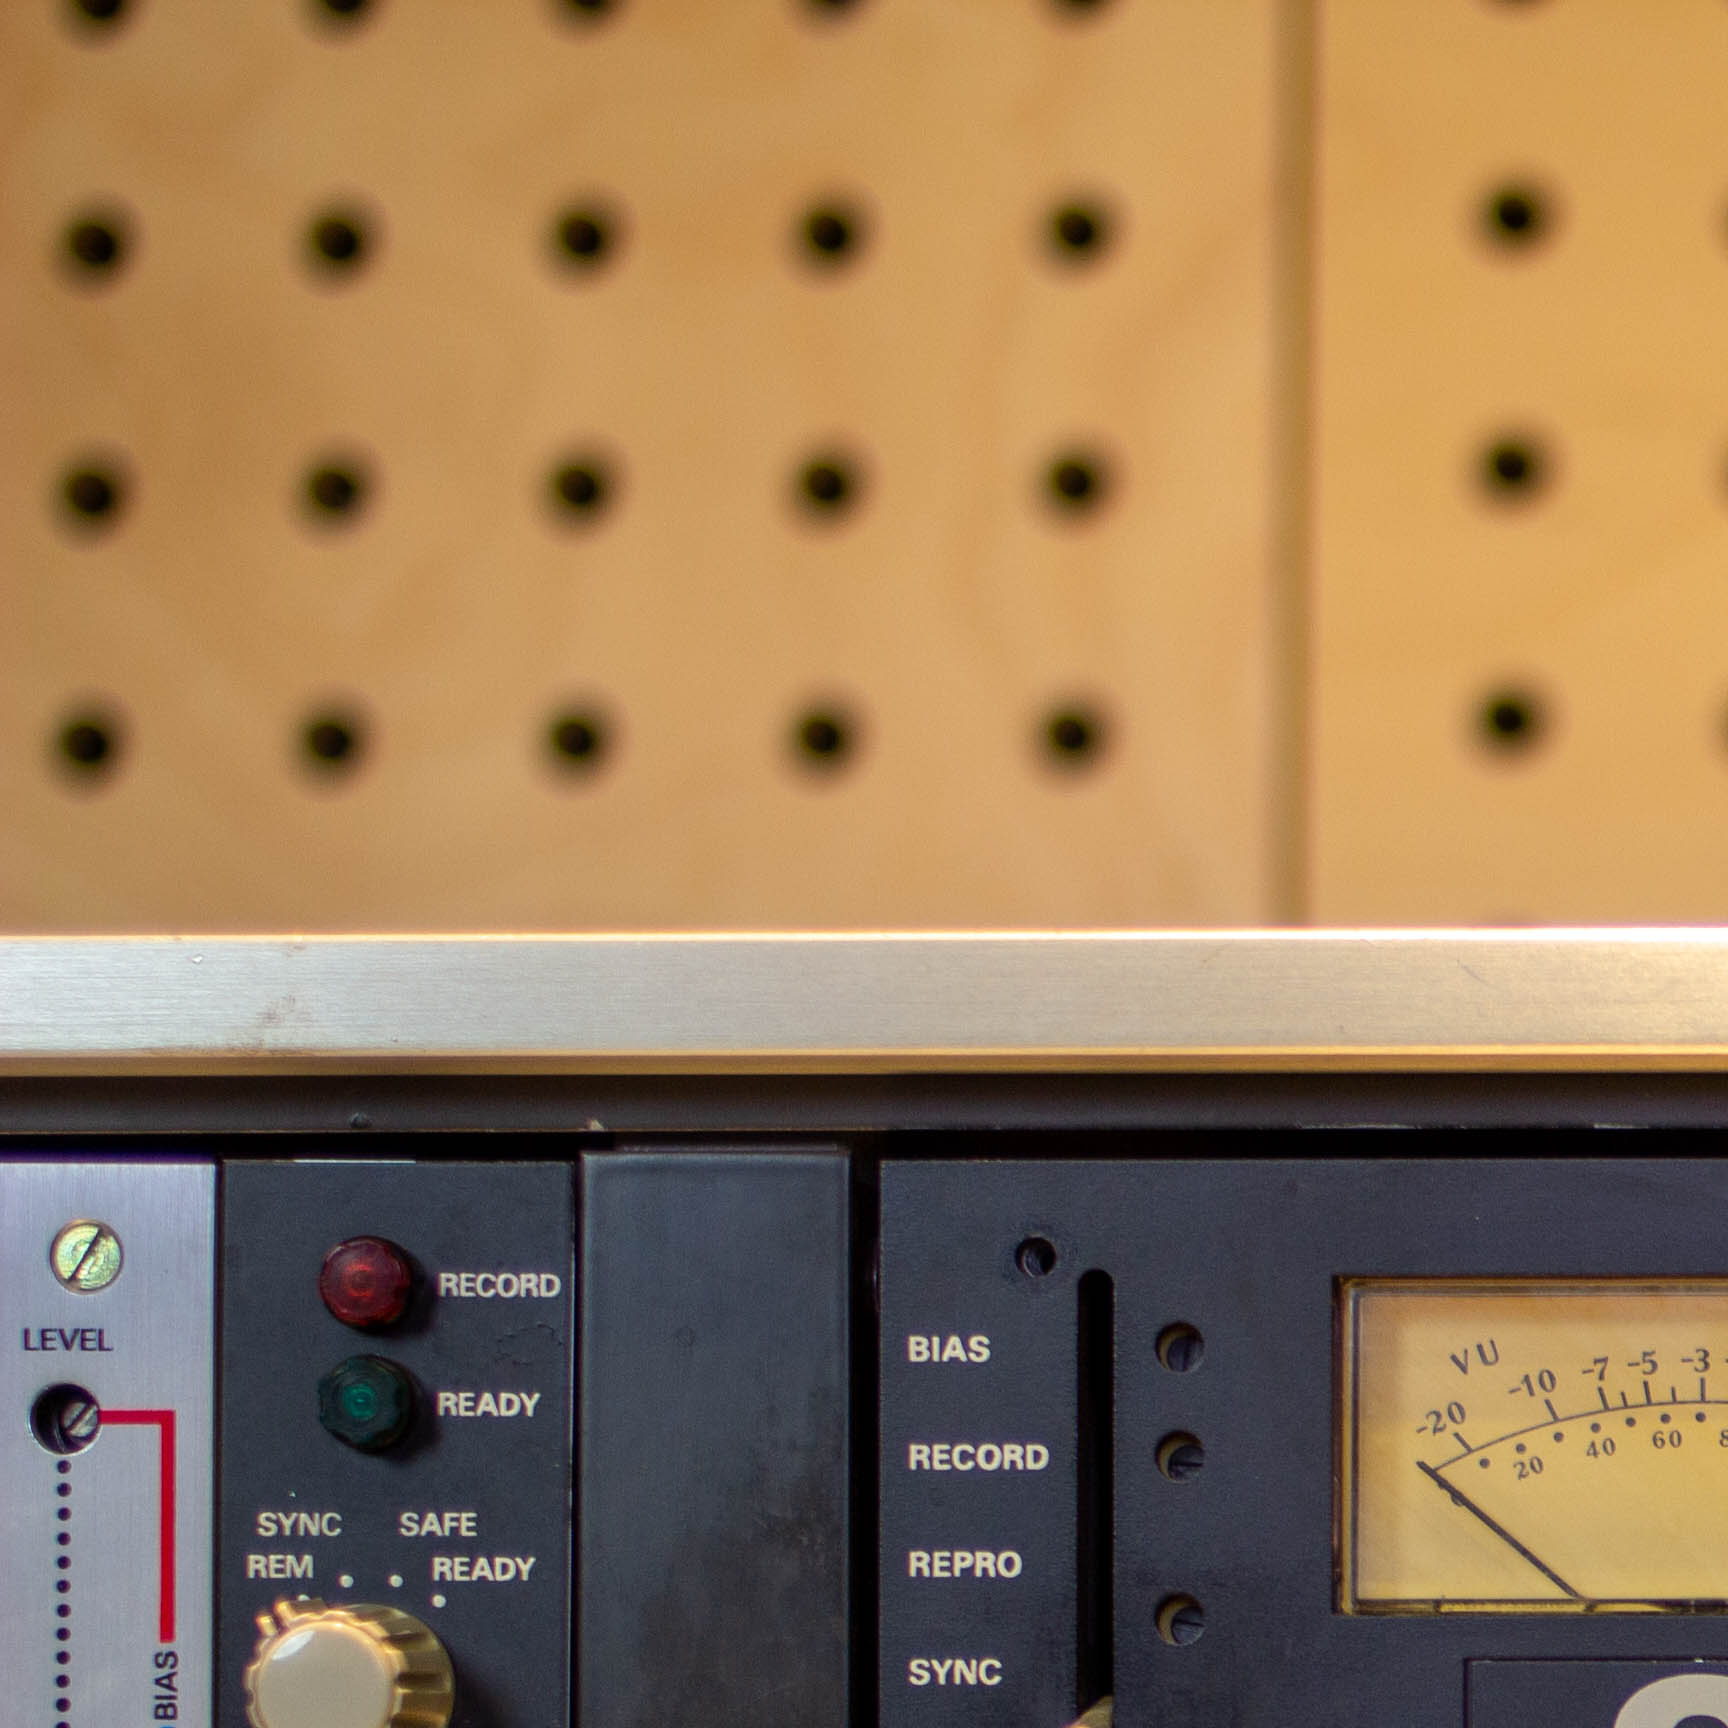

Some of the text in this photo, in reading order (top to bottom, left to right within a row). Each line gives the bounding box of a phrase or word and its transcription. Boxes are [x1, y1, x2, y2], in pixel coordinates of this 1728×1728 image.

[439, 1272, 562, 1298] RECORD
[23, 1327, 113, 1352] LEVEL
[908, 1335, 991, 1363] BIAS
[1449, 1339, 1499, 1375] VU
[438, 1391, 541, 1417] READY
[909, 1443, 1050, 1471] RECORD
[1513, 1456, 1544, 1480] 20
[1586, 1437, 1616, 1459] 40
[1652, 1430, 1682, 1449] 60
[257, 1511, 478, 1537] SYNC SAFE
[247, 1554, 536, 1582] REM READY
[909, 1550, 1023, 1578] REPRO
[153, 1650, 179, 1721] BIAS
[908, 1658, 1002, 1686] SYNC
